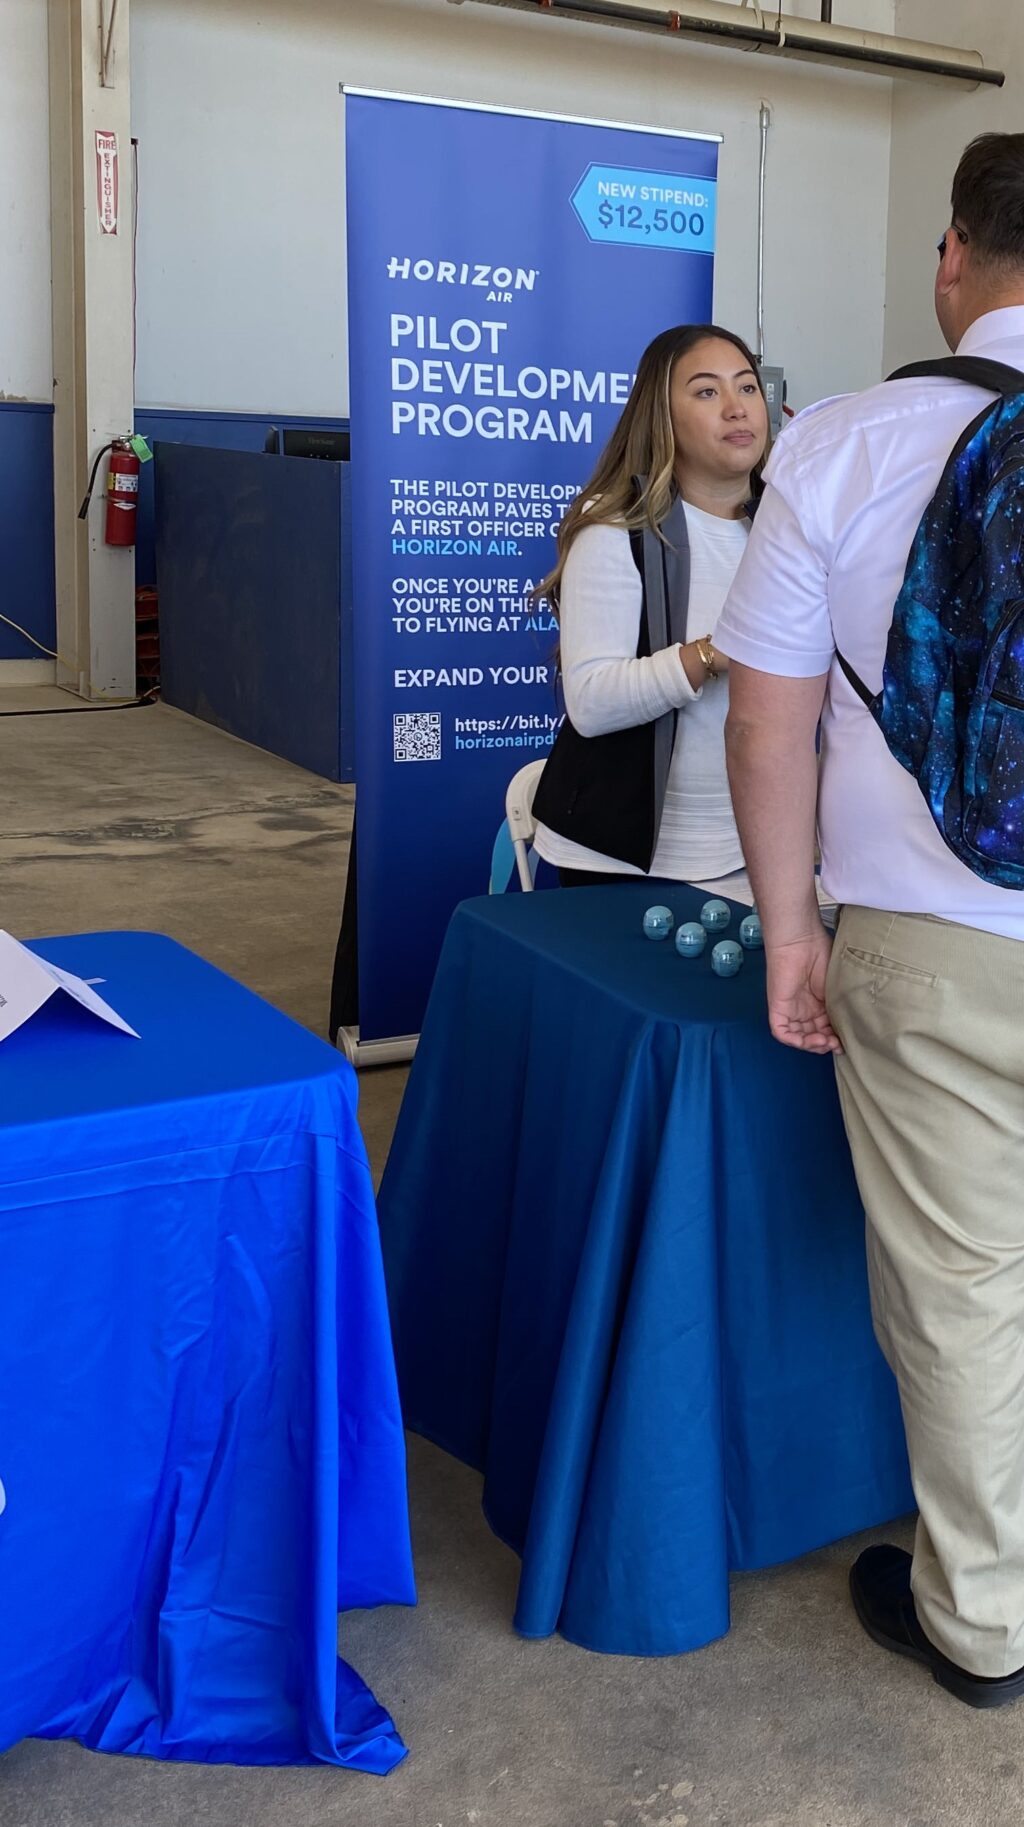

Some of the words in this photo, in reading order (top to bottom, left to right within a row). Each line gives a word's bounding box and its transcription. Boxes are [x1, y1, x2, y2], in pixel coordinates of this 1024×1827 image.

[98, 139, 116, 150] FIRE
[598, 181, 636, 199] NEW
[640, 186, 709, 208] STIPEND:
[598, 199, 705, 236] $12,500
[387, 256, 536, 291] HORIZON
[486, 291, 513, 303] AIR
[390, 313, 507, 354] PILOT
[392, 401, 592, 444] PROGRAM
[390, 479, 430, 496] THE
[434, 480, 489, 497] PILOT
[391, 498, 489, 517] PROGRAM
[494, 501, 553, 519] PAVES
[391, 518, 406, 535] A
[411, 519, 464, 536] FIRST
[467, 520, 546, 538] OFFICER
[392, 538, 482, 555] HORIZON
[486, 540, 523, 556] AIR.
[391, 577, 449, 594] ONCE
[452, 578, 519, 594] YOU'RE
[522, 578, 535, 594] A
[391, 597, 462, 613] YOU'RE
[465, 597, 494, 613] ON
[498, 597, 534, 613] THE
[392, 616, 421, 633] TO
[425, 616, 493, 633] FLYING
[496, 616, 522, 632] AT
[394, 668, 484, 688] EXPAND
[488, 666, 549, 685] YOUR
